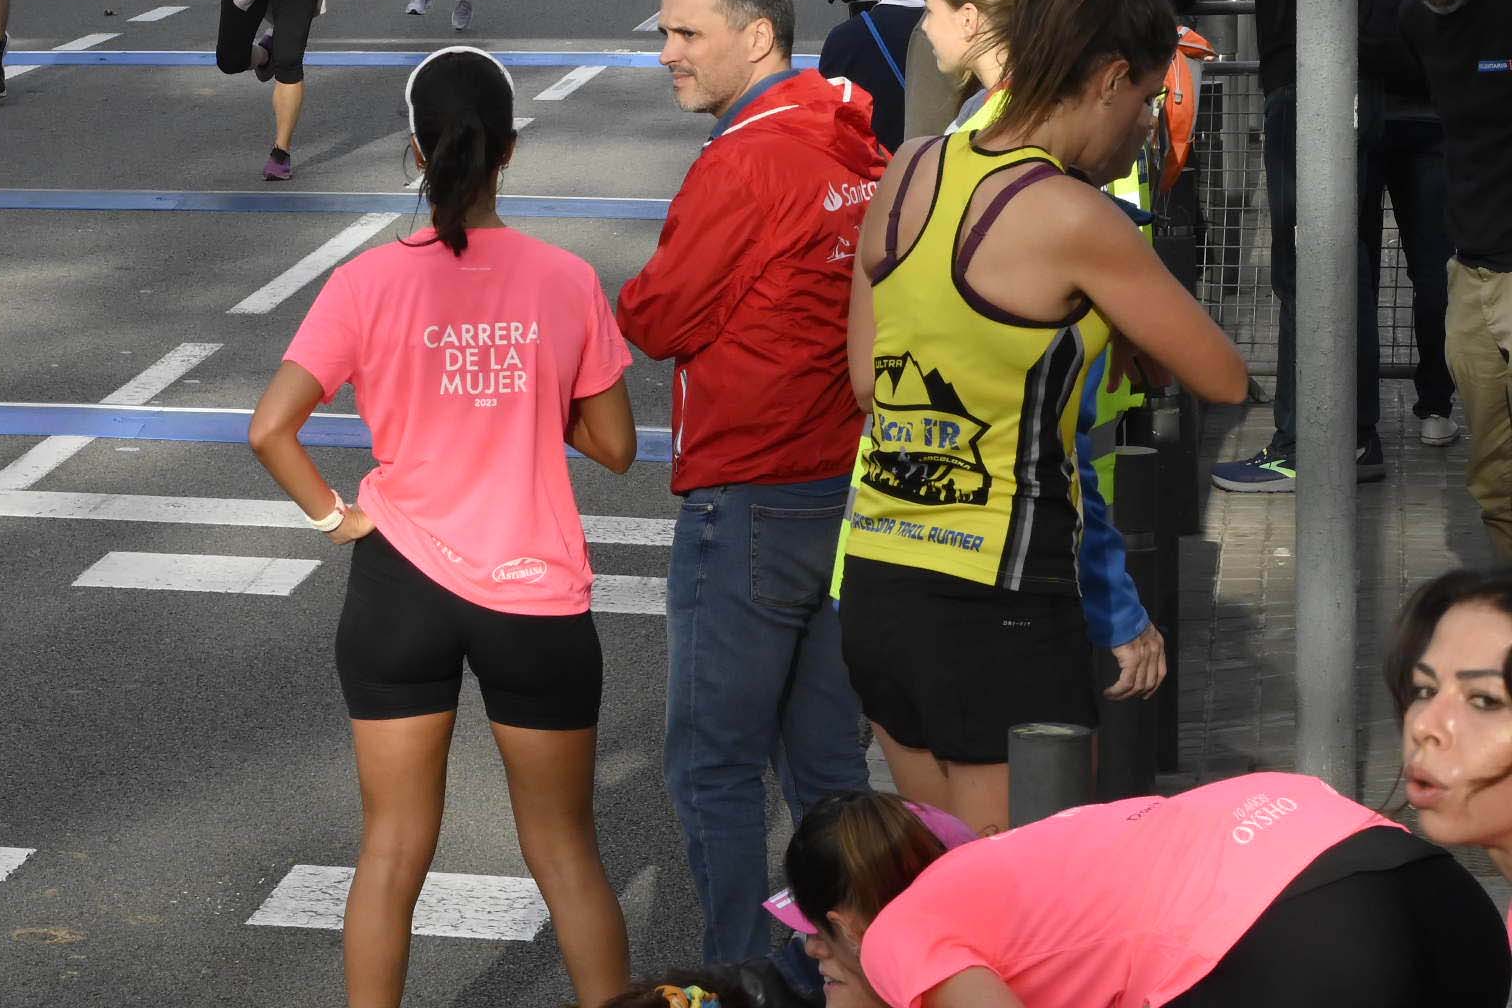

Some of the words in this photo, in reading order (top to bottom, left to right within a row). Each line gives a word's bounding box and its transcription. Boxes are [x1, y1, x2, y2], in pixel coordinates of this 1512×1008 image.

[423, 322, 540, 348] CARRERA
[445, 348, 479, 371] DE
[490, 347, 523, 370] LA
[439, 371, 528, 396] MUJER
[474, 397, 497, 408] 2023
[920, 417, 961, 451] TR
[928, 527, 985, 552] RUNNER
[1232, 796, 1299, 845] OYSHO
